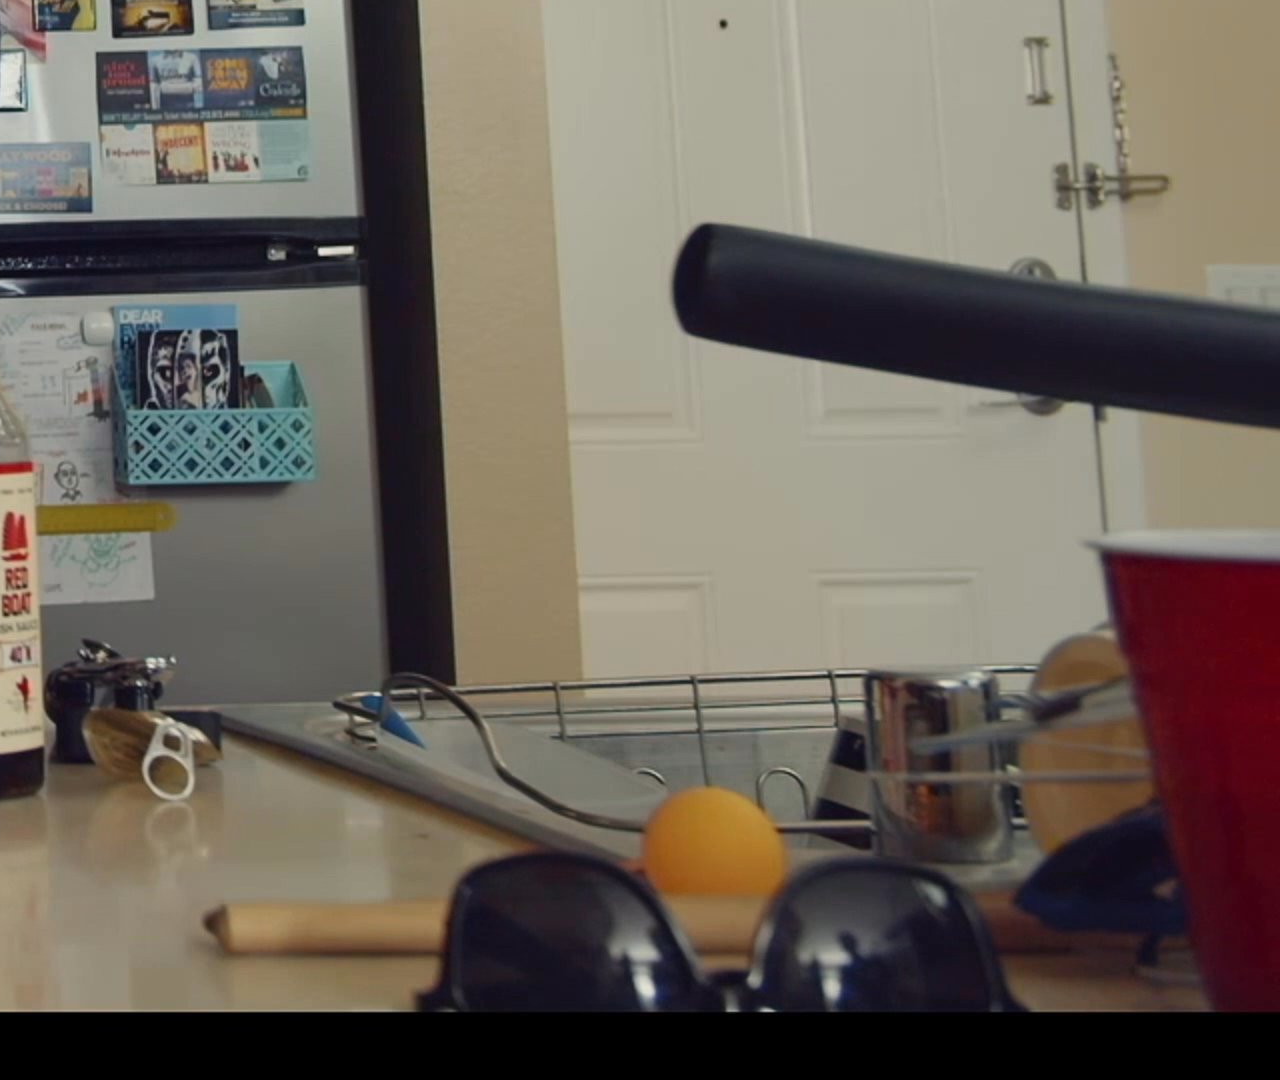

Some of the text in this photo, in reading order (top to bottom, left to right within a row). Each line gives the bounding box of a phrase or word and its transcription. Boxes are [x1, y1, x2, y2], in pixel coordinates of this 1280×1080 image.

[119, 310, 162, 323] DEAR
[4, 567, 30, 590] RED
[1, 592, 33, 618] BOAT
